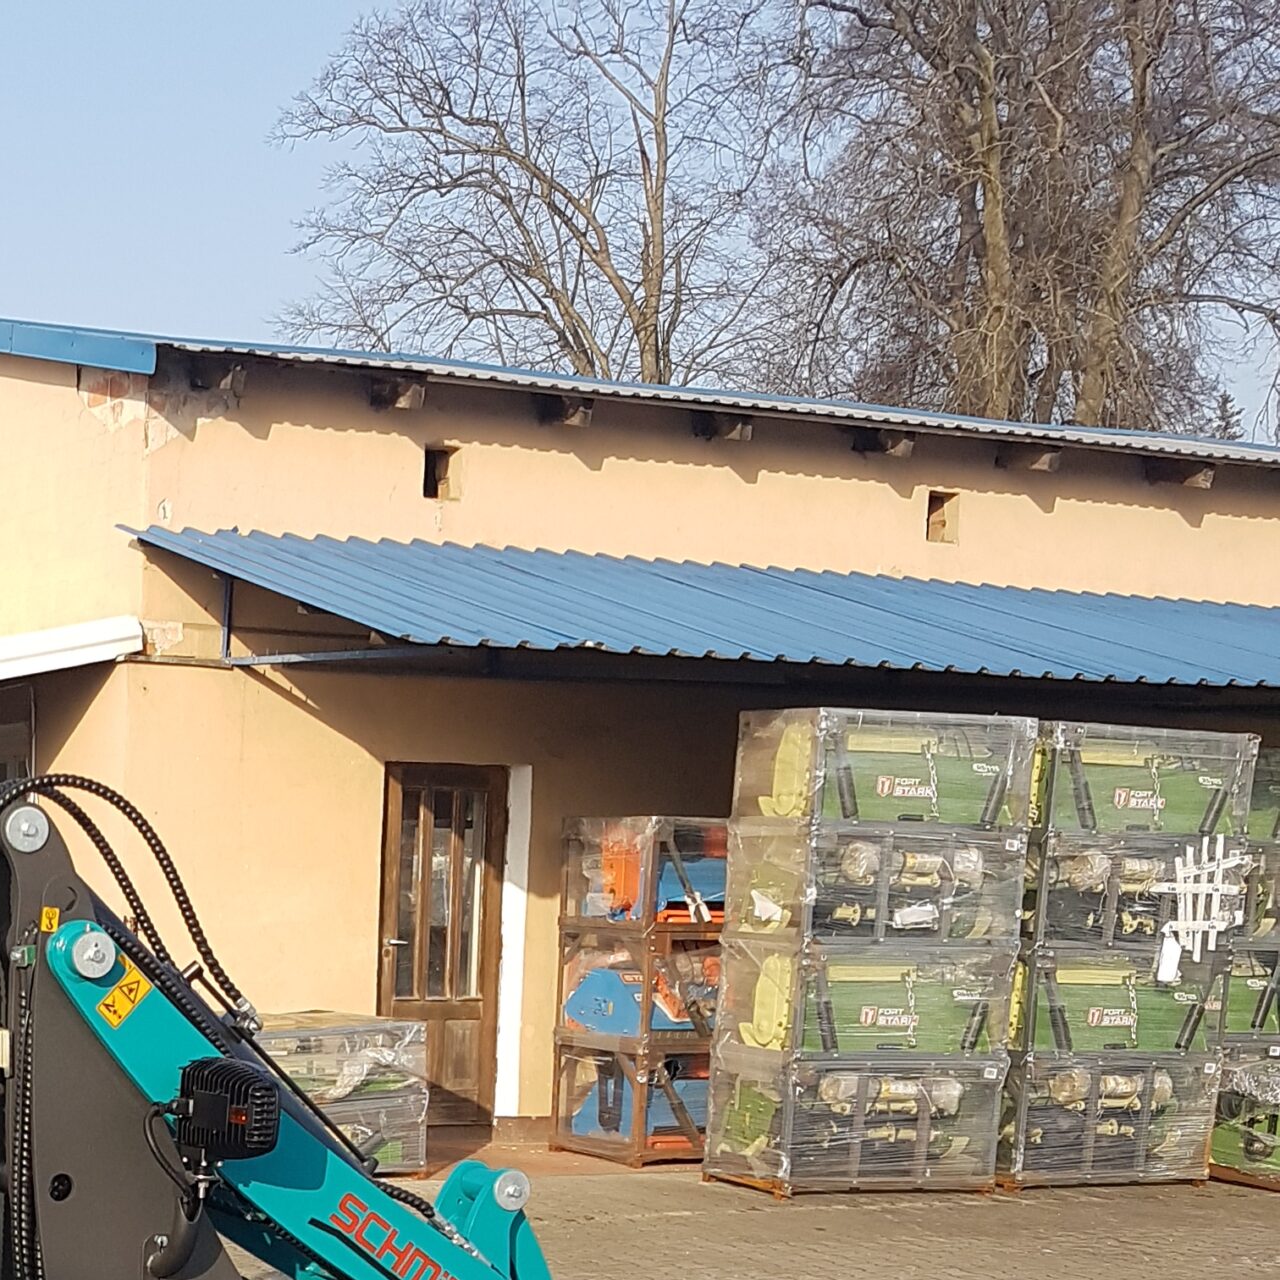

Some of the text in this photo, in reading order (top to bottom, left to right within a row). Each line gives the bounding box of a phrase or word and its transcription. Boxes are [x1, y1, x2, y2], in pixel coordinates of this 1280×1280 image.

[894, 777, 921, 786] FORT
[1129, 790, 1154, 798] FORT
[878, 1008, 905, 1016] FORT
[1103, 1008, 1126, 1016] FORT
